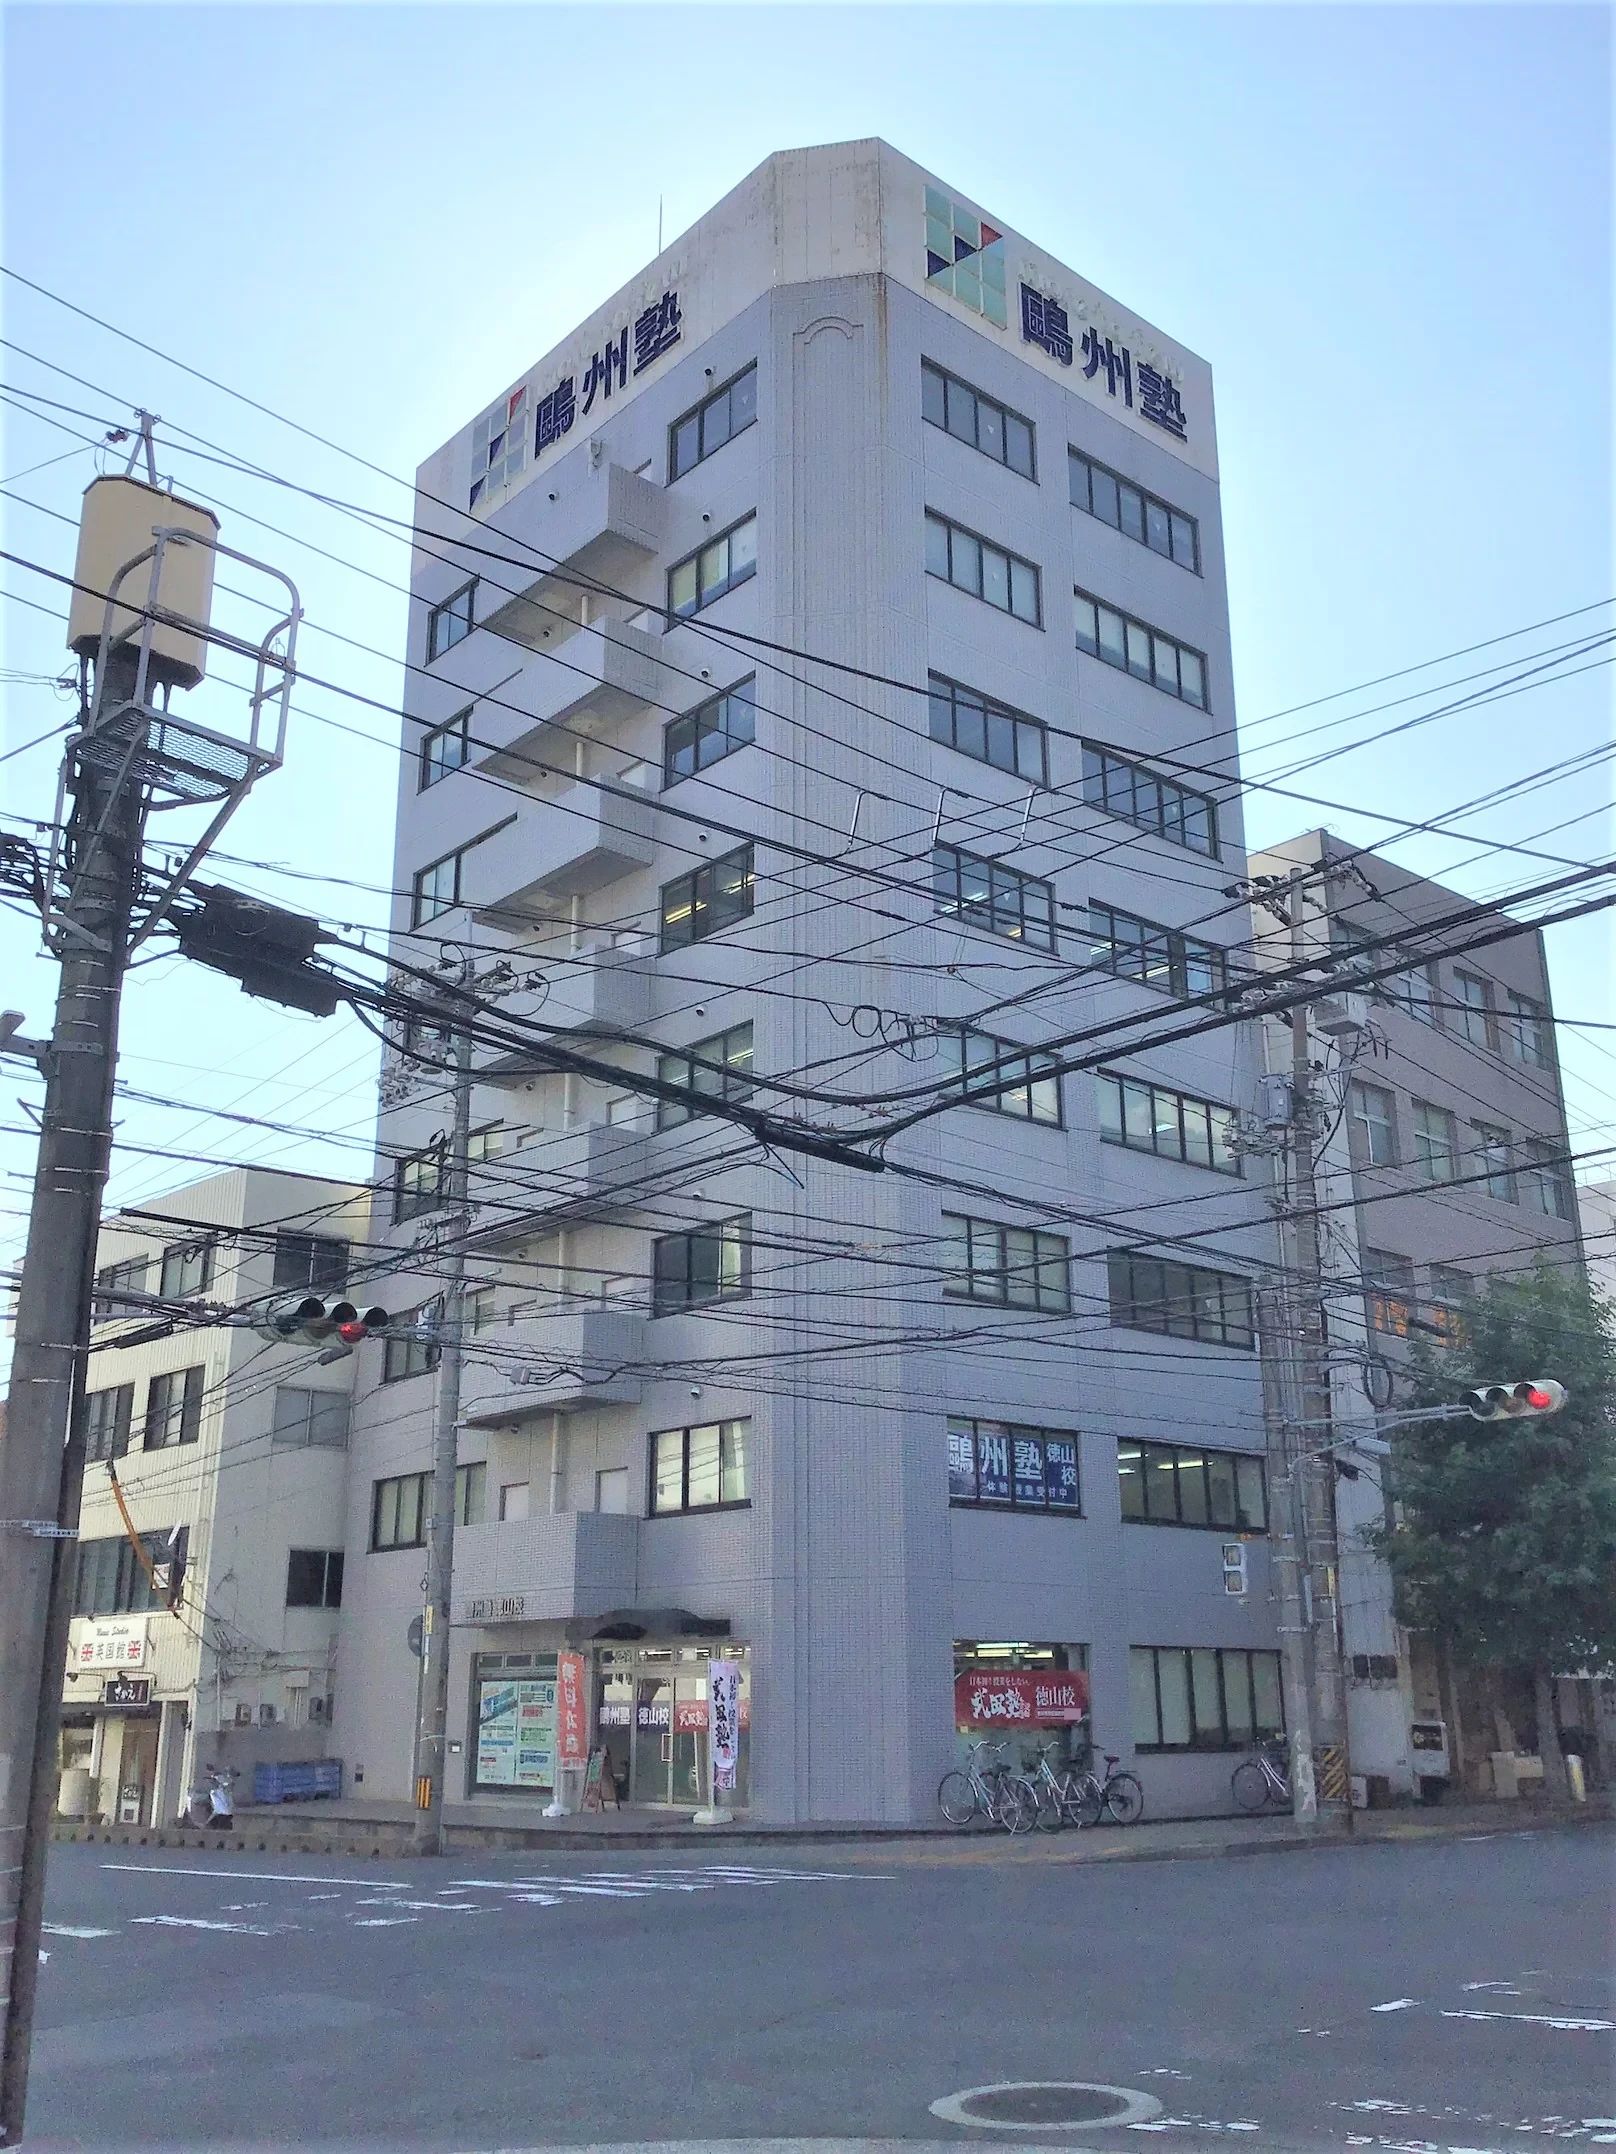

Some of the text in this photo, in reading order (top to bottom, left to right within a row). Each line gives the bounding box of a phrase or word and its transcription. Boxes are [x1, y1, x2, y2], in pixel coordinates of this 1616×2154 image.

[1035, 1685, 1076, 1707] 徳山校
[638, 1706, 670, 1726] 徳山校
